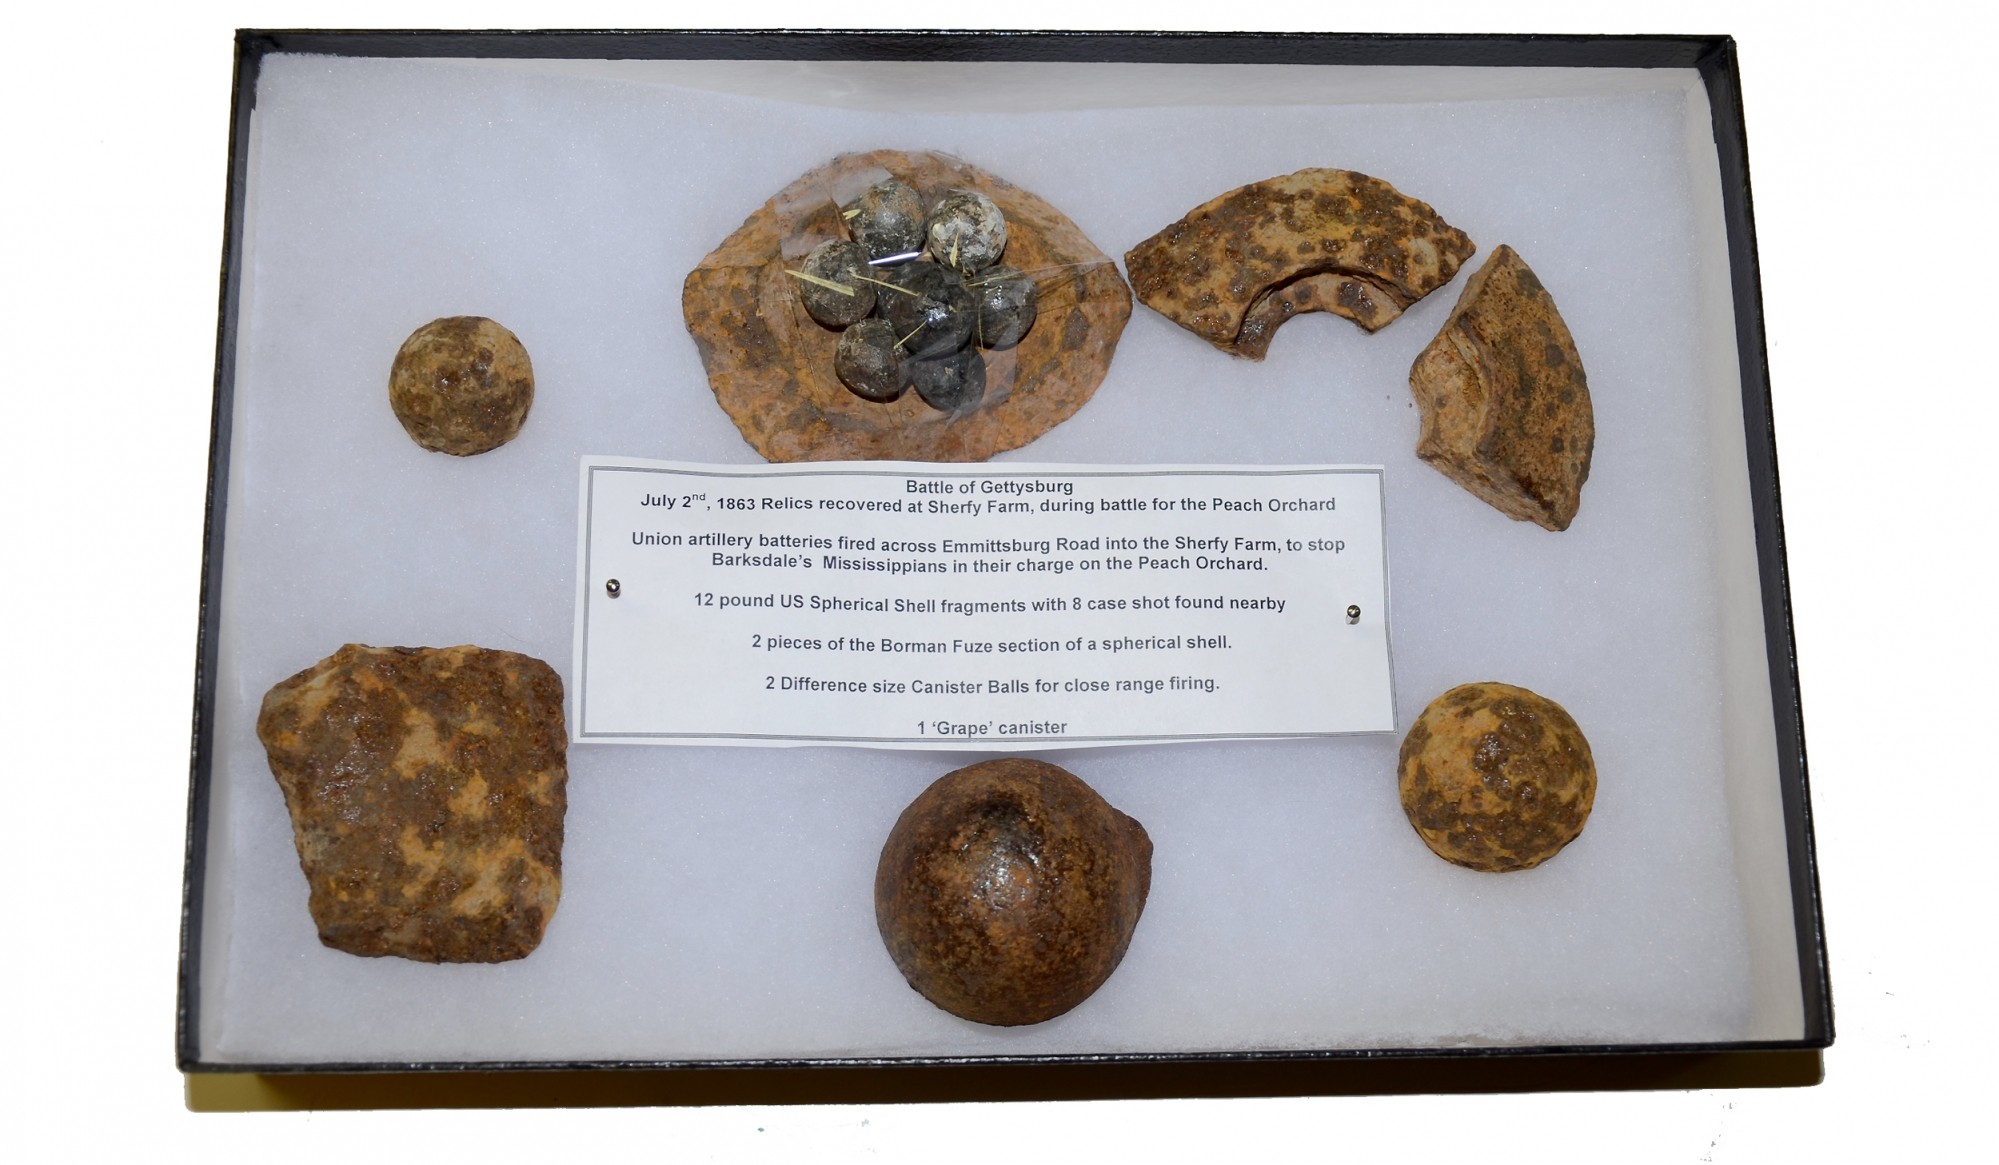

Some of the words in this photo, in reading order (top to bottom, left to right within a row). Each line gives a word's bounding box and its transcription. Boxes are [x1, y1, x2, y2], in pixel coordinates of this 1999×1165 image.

[906, 479, 954, 495] Battle
[958, 480, 977, 495] of
[980, 479, 1074, 497] Gettysburg
[640, 493, 677, 511] July
[716, 497, 756, 511] 1863
[761, 496, 814, 510] Relics
[819, 498, 902, 513] recovered
[907, 500, 924, 514] at
[927, 499, 982, 518] Sherfy
[987, 499, 1035, 515] Farm,
[1039, 498, 1095, 515] during
[1100, 497, 1148, 512] battle
[1151, 497, 1177, 511] for
[1180, 497, 1207, 511] the
[1212, 497, 1263, 512] Peach
[1268, 497, 1336, 513] Orchard
[632, 531, 682, 546] Union
[688, 532, 753, 550] artillery
[759, 533, 833, 550] batteries
[837, 535, 876, 551] fired
[880, 540, 937, 553] across
[942, 538, 1050, 555] Emmittsburg
[1056, 536, 1100, 551] Road
[1105, 536, 1138, 550] into
[1142, 536, 1170, 550] the
[1174, 535, 1229, 554] Sherfy
[1234, 537, 1282, 554] Farm,
[1285, 538, 1303, 552] to
[1308, 538, 1346, 555] stop
[823, 555, 948, 576] Mississippians
[953, 559, 968, 573] in
[972, 558, 1012, 573] their
[1016, 557, 1075, 575] charge
[1079, 559, 1101, 571] on
[1105, 556, 1133, 570] the
[1138, 555, 1190, 570] Peach
[1195, 555, 1268, 571] Orchard.
[694, 592, 714, 607] 12
[719, 593, 774, 610] pound
[780, 593, 804, 609] US
[809, 595, 889, 613] Spherical
[894, 598, 936, 613] Shell
[940, 599, 1027, 617] fragments
[1031, 597, 1067, 612] with
[1072, 596, 1082, 611] 8
[1087, 599, 1127, 611] case
[1131, 595, 1171, 610] shot
[1174, 594, 1224, 609] found
[1229, 596, 1286, 614] nearby
[751, 633, 762, 648] 2
[767, 634, 822, 652] pieces
[827, 636, 845, 651] of
[848, 637, 876, 652] the
[881, 638, 947, 654] Borman
[953, 639, 993, 654] Fuze
[997, 638, 1060, 653] section
[1065, 636, 1083, 652] of
[1087, 639, 1097, 651] a
[1102, 634, 1181, 654] spherical
[1186, 634, 1232, 649] shell.
[765, 675, 775, 690] 2
[781, 676, 868, 693] Difference
[872, 679, 906, 694] size
[911, 679, 983, 695] Canister
[988, 679, 1030, 694] Balls
[1034, 678, 1060, 693] for
[1064, 678, 1110, 693] close
[1115, 679, 1165, 695] range
[1169, 675, 1220, 694] firing.
[917, 720, 925, 735] 1
[998, 720, 1068, 735] canister
